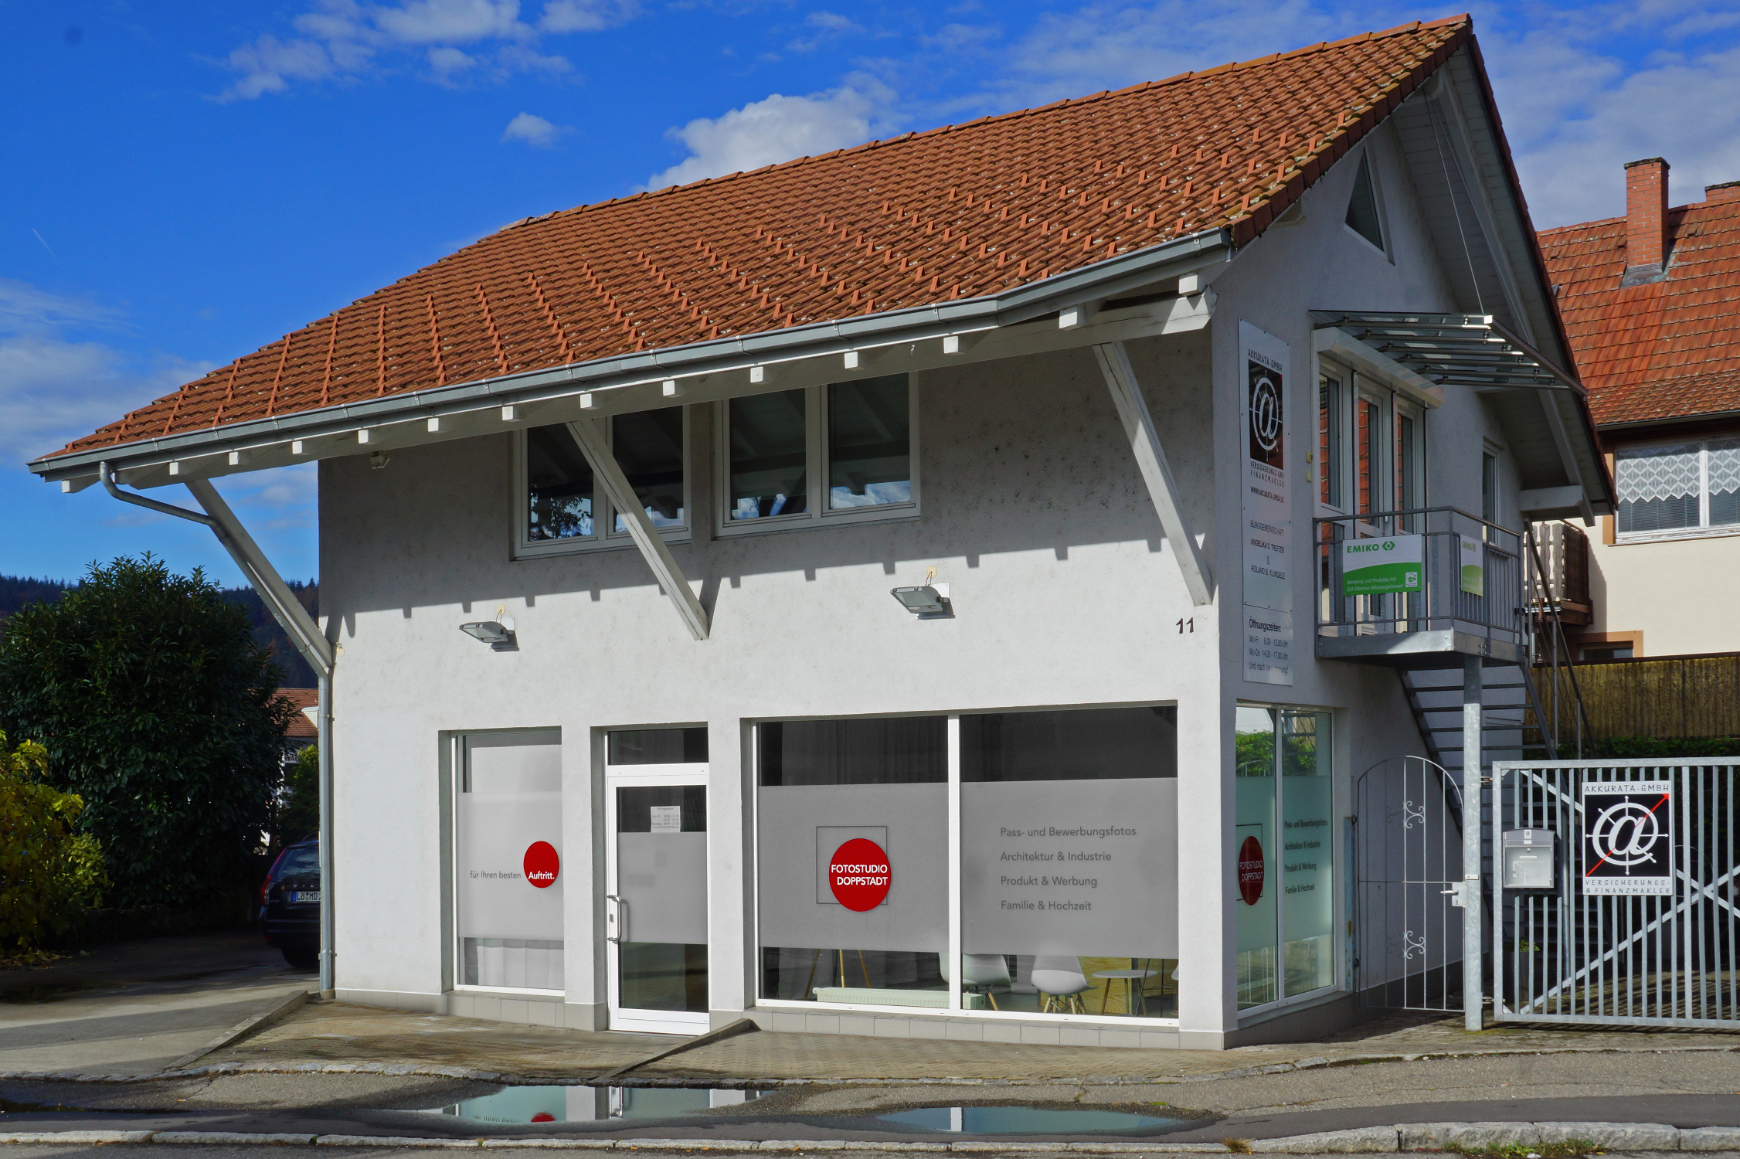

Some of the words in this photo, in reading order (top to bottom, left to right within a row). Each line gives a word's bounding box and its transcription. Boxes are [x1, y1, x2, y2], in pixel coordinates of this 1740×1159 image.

[1347, 544, 1379, 553] EMIKO
[1176, 617, 1194, 634] 11
[1000, 827, 1024, 837] Pass-
[1028, 827, 1046, 837] und
[1049, 826, 1136, 838] Bewerbungsfotos
[1000, 851, 1054, 861] Architektur
[1057, 851, 1065, 861] &
[1068, 851, 1111, 861] Industrie
[831, 864, 888, 873] FOTOSTUDIO
[1240, 860, 1264, 870] FOTOSTUDIO
[528, 871, 555, 880] Auftritt.
[1242, 872, 1264, 881] DOPPSTADT
[837, 877, 888, 886] DOPPSTADT
[1000, 876, 1038, 886] Produkt
[1041, 876, 1049, 886] &
[1052, 876, 1098, 888] Werbung
[1001, 900, 1035, 910] Familie
[1038, 900, 1045, 910] &
[1049, 900, 1091, 910] Hochzeit
